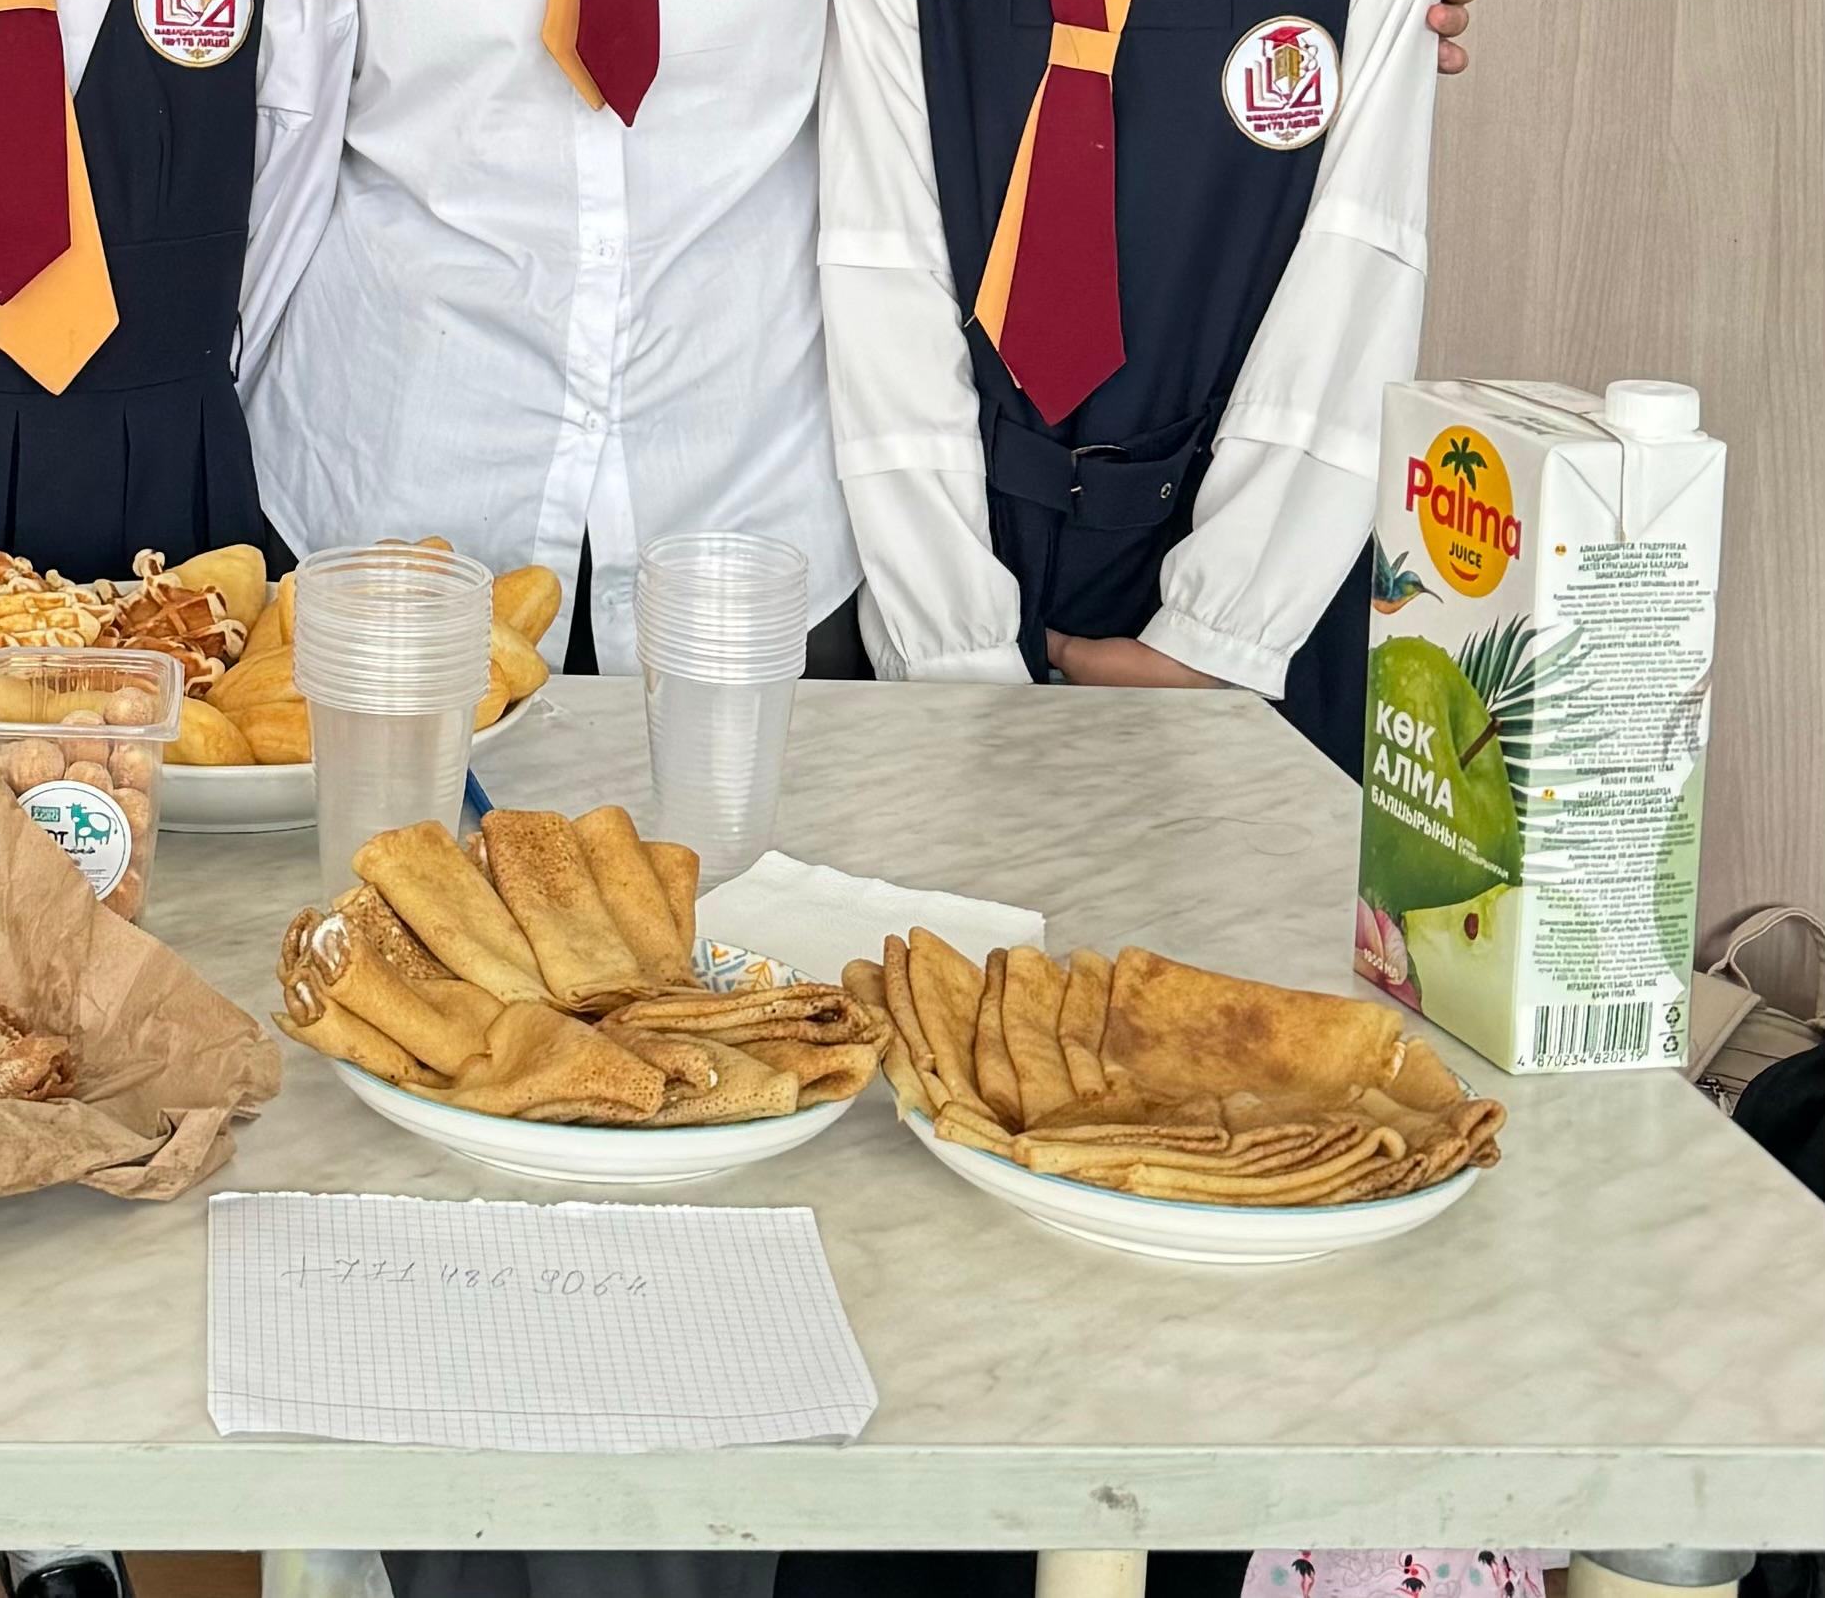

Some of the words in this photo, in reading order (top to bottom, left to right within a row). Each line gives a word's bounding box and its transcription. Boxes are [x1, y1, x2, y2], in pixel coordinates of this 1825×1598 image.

[1406, 456, 1522, 560] Palma
[1448, 541, 1483, 570] JUICE
[1375, 699, 1437, 763] КӨК
[1372, 743, 1455, 819] АЛМА
[1371, 784, 1458, 851] БАЛШЫРЫНЫ
[1536, 1052, 1587, 1068] 870234
[1593, 1045, 1646, 1065] 820219
